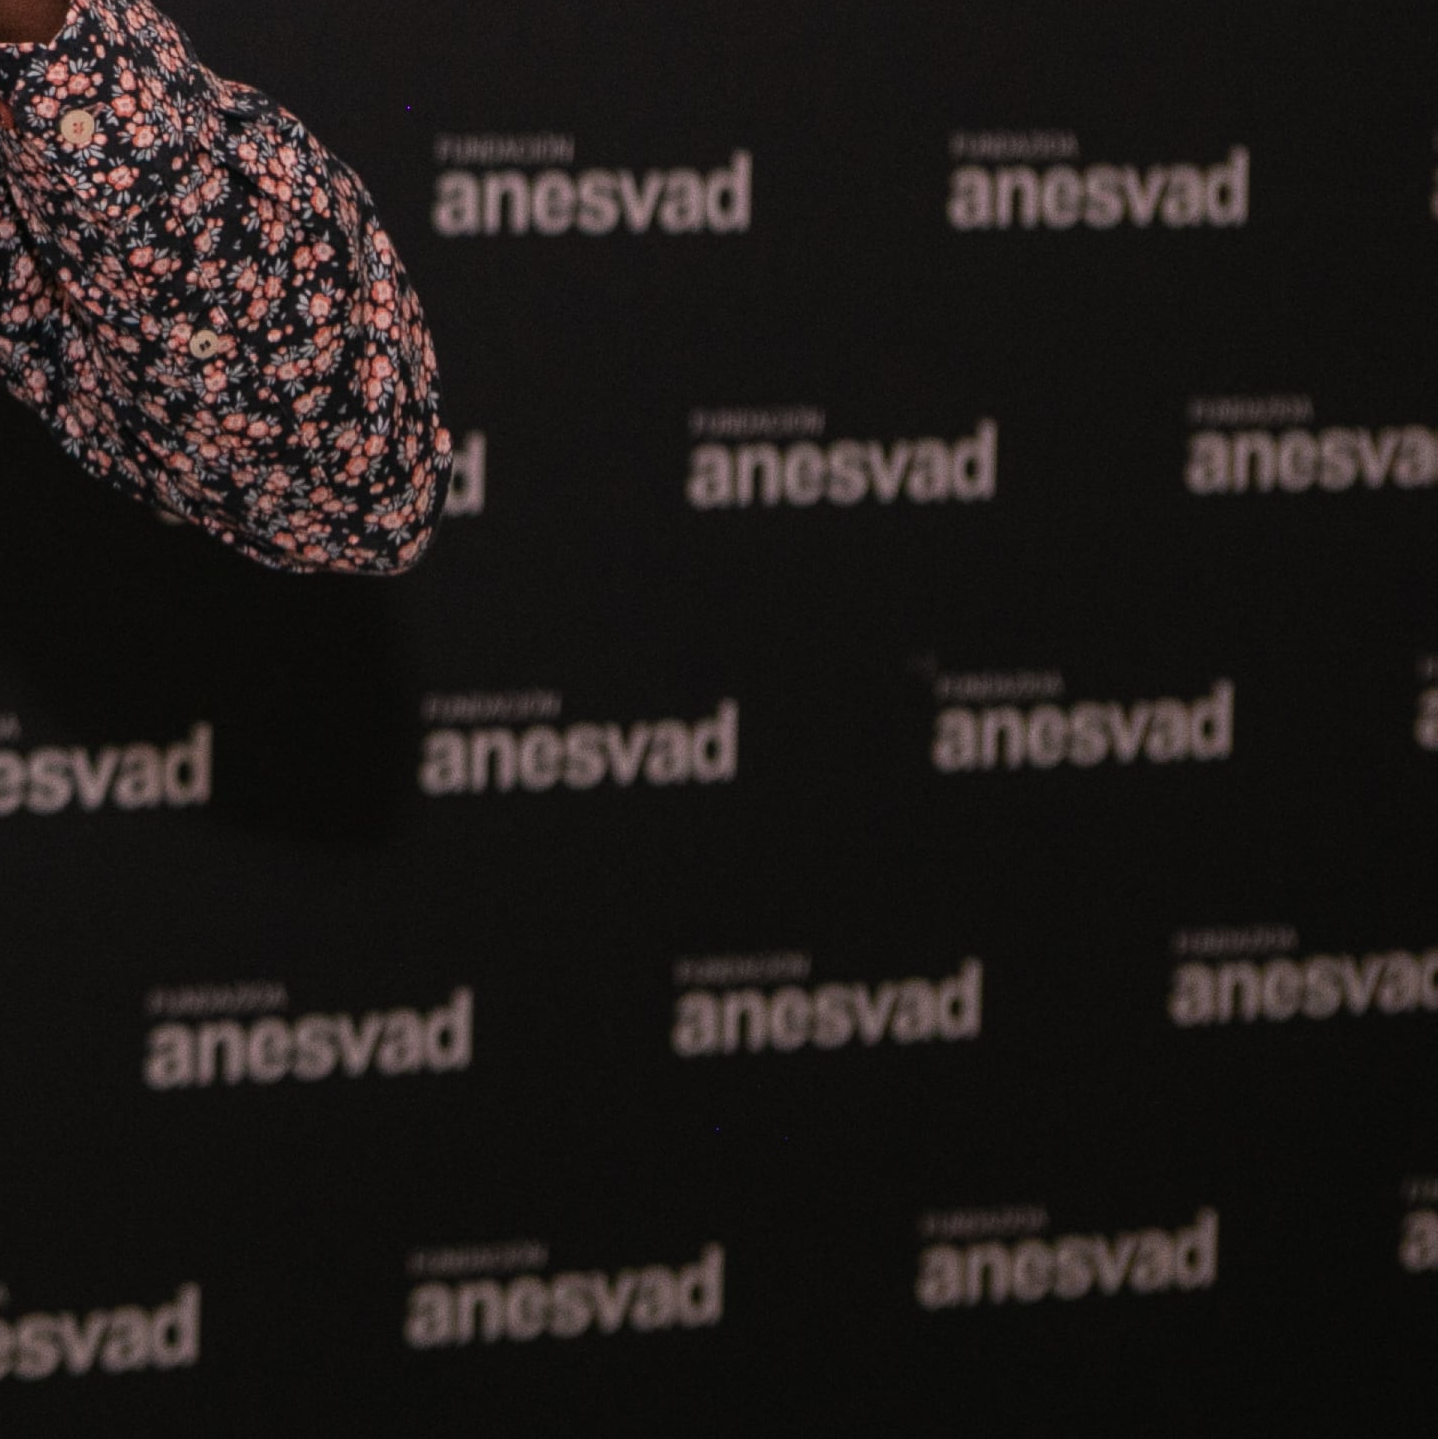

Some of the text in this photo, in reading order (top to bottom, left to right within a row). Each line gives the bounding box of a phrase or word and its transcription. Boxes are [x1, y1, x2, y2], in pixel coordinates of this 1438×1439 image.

[435, 152, 750, 234] anesvad
[950, 149, 1248, 228] anesvad
[689, 422, 995, 507] anesvad
[1189, 428, 1438, 493] anesva
[423, 703, 736, 792] anesvad
[936, 684, 1231, 769] anesvad
[676, 963, 980, 1053] anesvad
[1173, 953, 1438, 1023] anesva
[148, 991, 471, 1087] anesvad
[409, 1249, 721, 1344] anesvad
[921, 1215, 1215, 1304] anesvad
